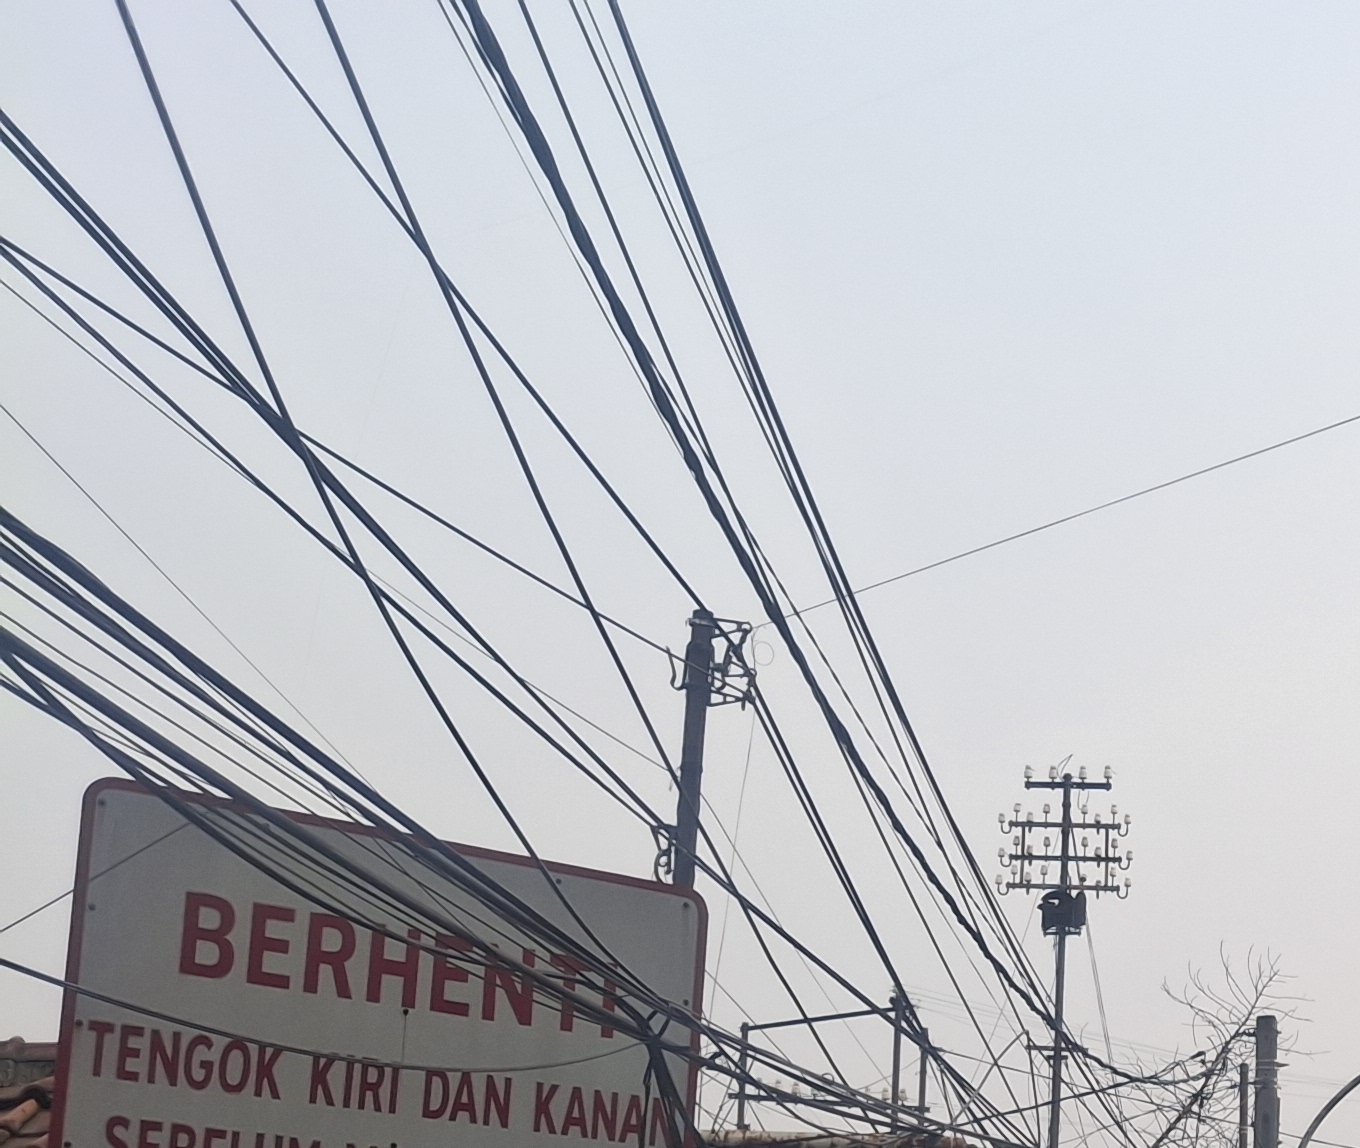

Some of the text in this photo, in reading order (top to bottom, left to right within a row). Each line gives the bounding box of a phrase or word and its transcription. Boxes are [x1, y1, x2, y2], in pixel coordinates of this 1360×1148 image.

[88, 1019, 282, 1100] TENGOK
[308, 1052, 399, 1114] KIRI
[421, 1067, 512, 1130] DAN
